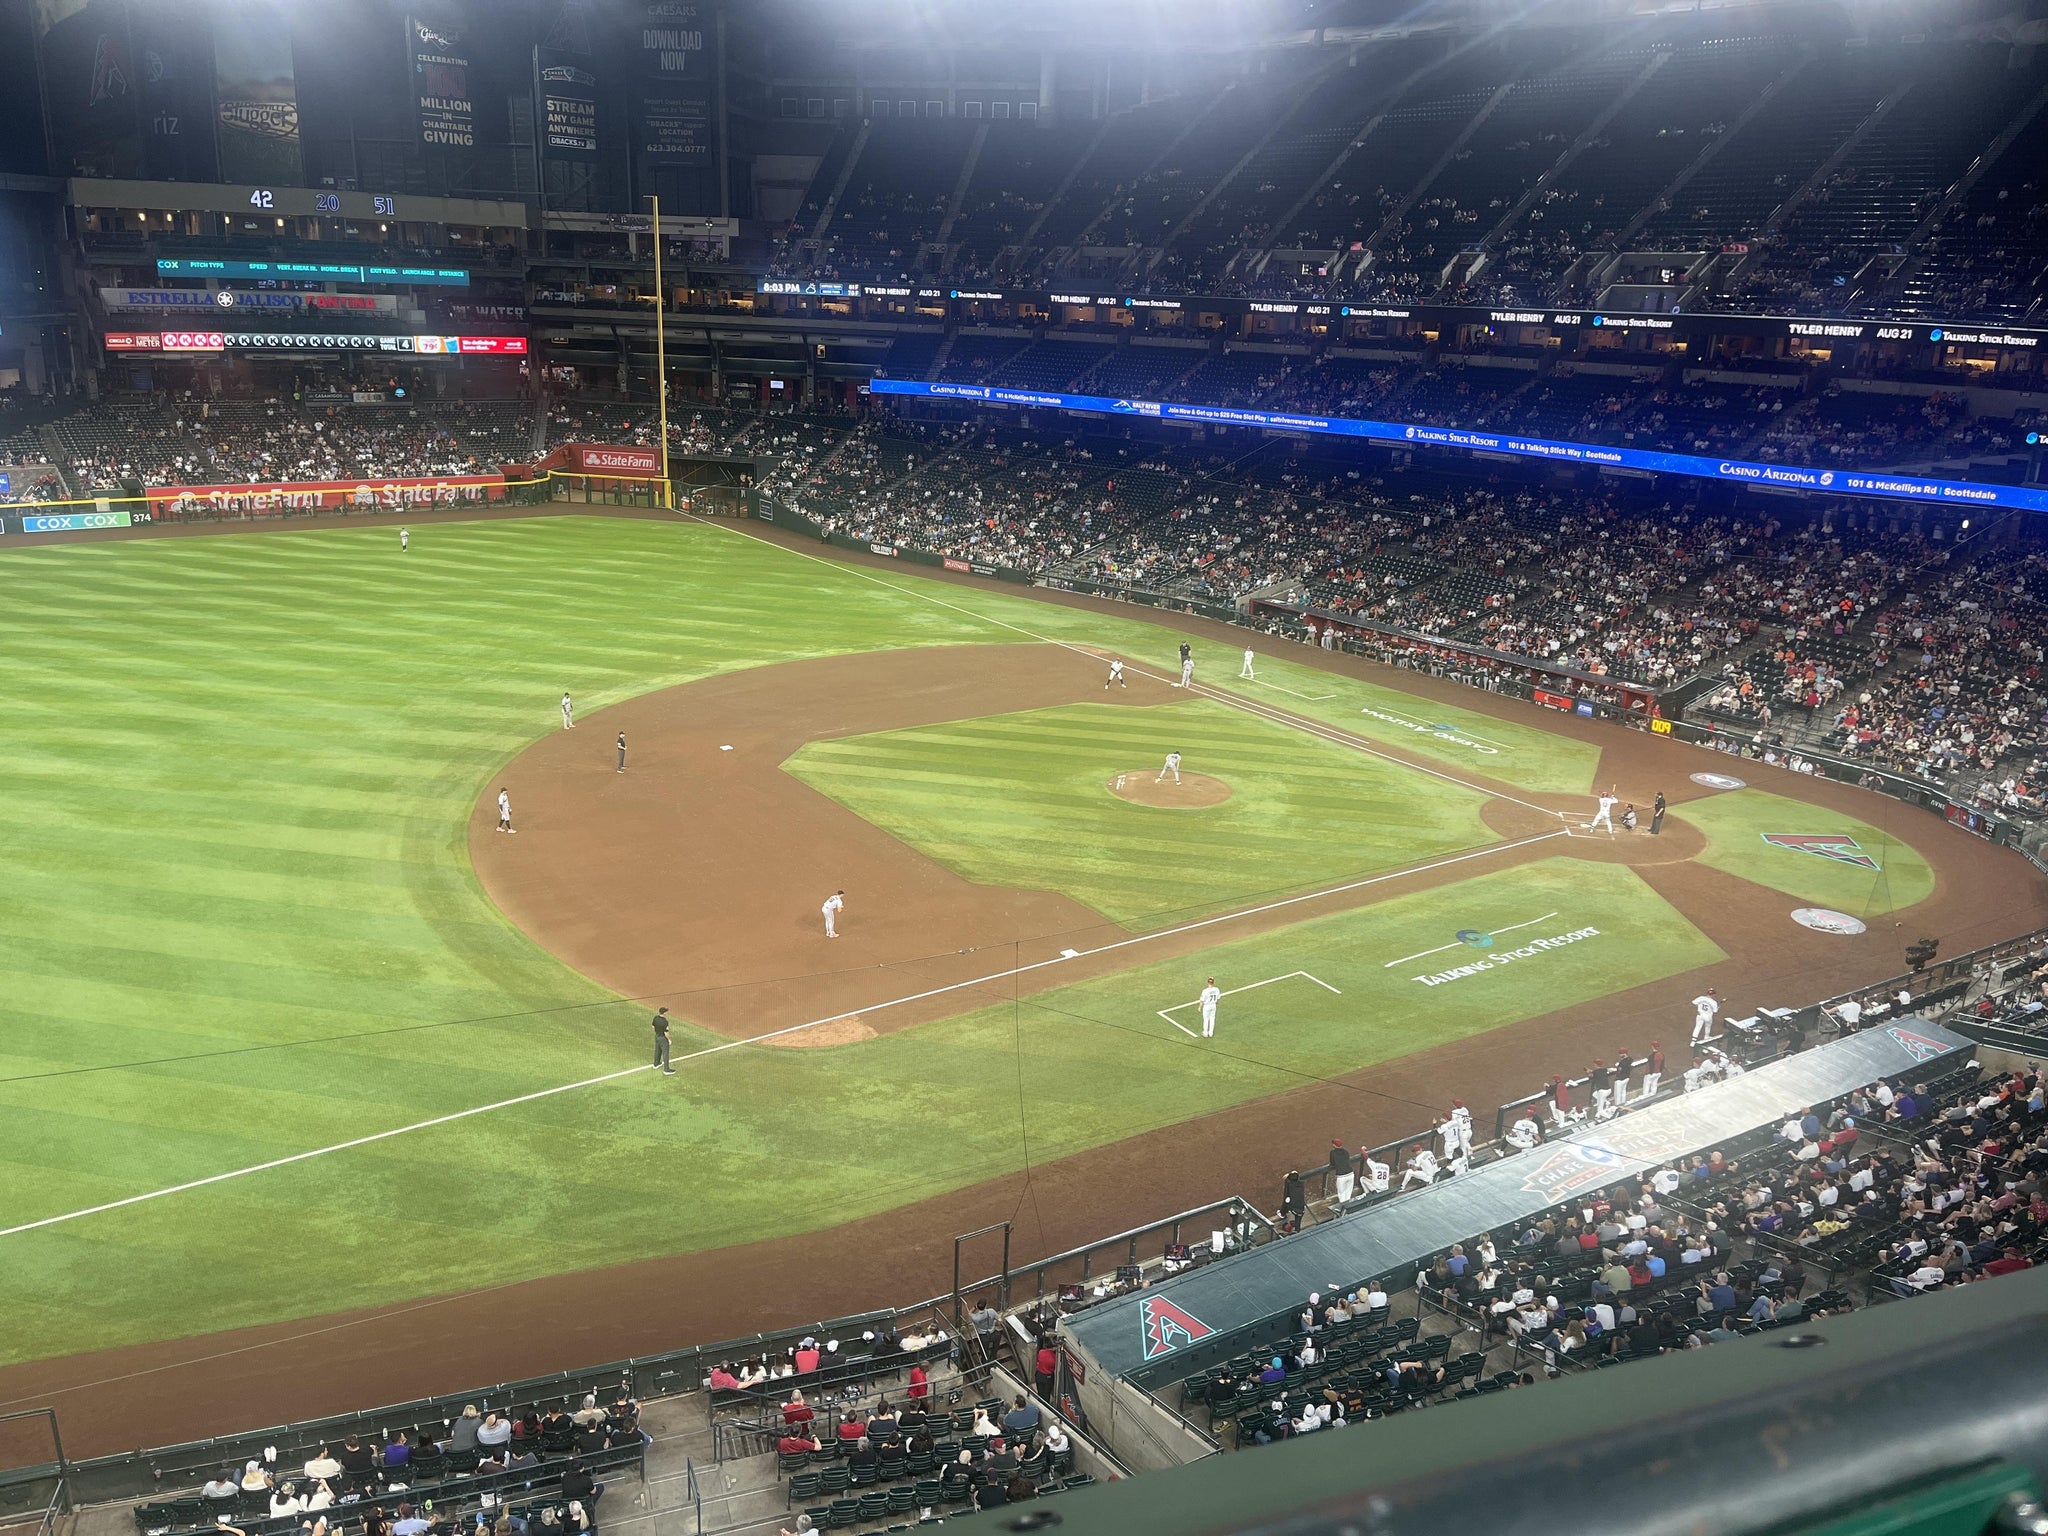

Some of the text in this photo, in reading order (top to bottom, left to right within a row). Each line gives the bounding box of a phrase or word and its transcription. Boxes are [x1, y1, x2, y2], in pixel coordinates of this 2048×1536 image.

[643, 30, 702, 50] DOWNLOAD
[418, 54, 468, 66] CELEBRATING
[660, 51, 686, 70] NOW
[420, 97, 472, 112] MILLION
[546, 100, 594, 115] STREAM
[222, 103, 288, 130] Slugger
[442, 112, 452, 120] IN
[548, 114, 595, 126] ANY GAME
[422, 120, 472, 132] CHARITABLE
[548, 124, 595, 136] ANYWHERE
[424, 131, 473, 146] GIVING
[250, 190, 273, 208] 42
[316, 194, 340, 211] 20
[374, 197, 394, 215] 51
[764, 283, 800, 292] 8:03 PM
[864, 287, 886, 295] TYLER
[128, 292, 302, 307] ESTRELLA JALISCO
[1273, 304, 1298, 313] HENRY
[1491, 312, 1544, 322] TYLER HENRY
[1554, 315, 1581, 324] AUG 21
[1602, 318, 1672, 328] TALKING STICK RESORT
[1789, 324, 1863, 337] TYLER HENRY
[1877, 328, 1912, 339] AUG 21
[402, 340, 410, 349] 4
[1943, 332, 2038, 346] TALKING STICK RESORT
[930, 385, 983, 397] CASINO ARIZONA
[1416, 430, 1499, 447] TALKING STICK RESORT
[1527, 443, 1549, 454] Talking
[1550, 446, 1566, 455] Stick
[1568, 448, 1582, 458] Way
[1586, 450, 1621, 461] Scottsdale
[1719, 463, 1816, 484] CASINO ARIZONA
[1847, 478, 1937, 495] 101 & McKellips Rd
[1944, 487, 1996, 500] Scottsdale
[37, 515, 118, 529] COX COX
[133, 514, 151, 522] 374
[1361, 708, 1498, 754] CASINO ARIZONA
[1411, 926, 1601, 986] TALKING STICK RESORT
[1618, 1135, 1667, 1151] FIELD
[1428, 1157, 1437, 1166] 12
[1377, 1171, 1387, 1180] 28
[1538, 1161, 1584, 1185] CHASE
